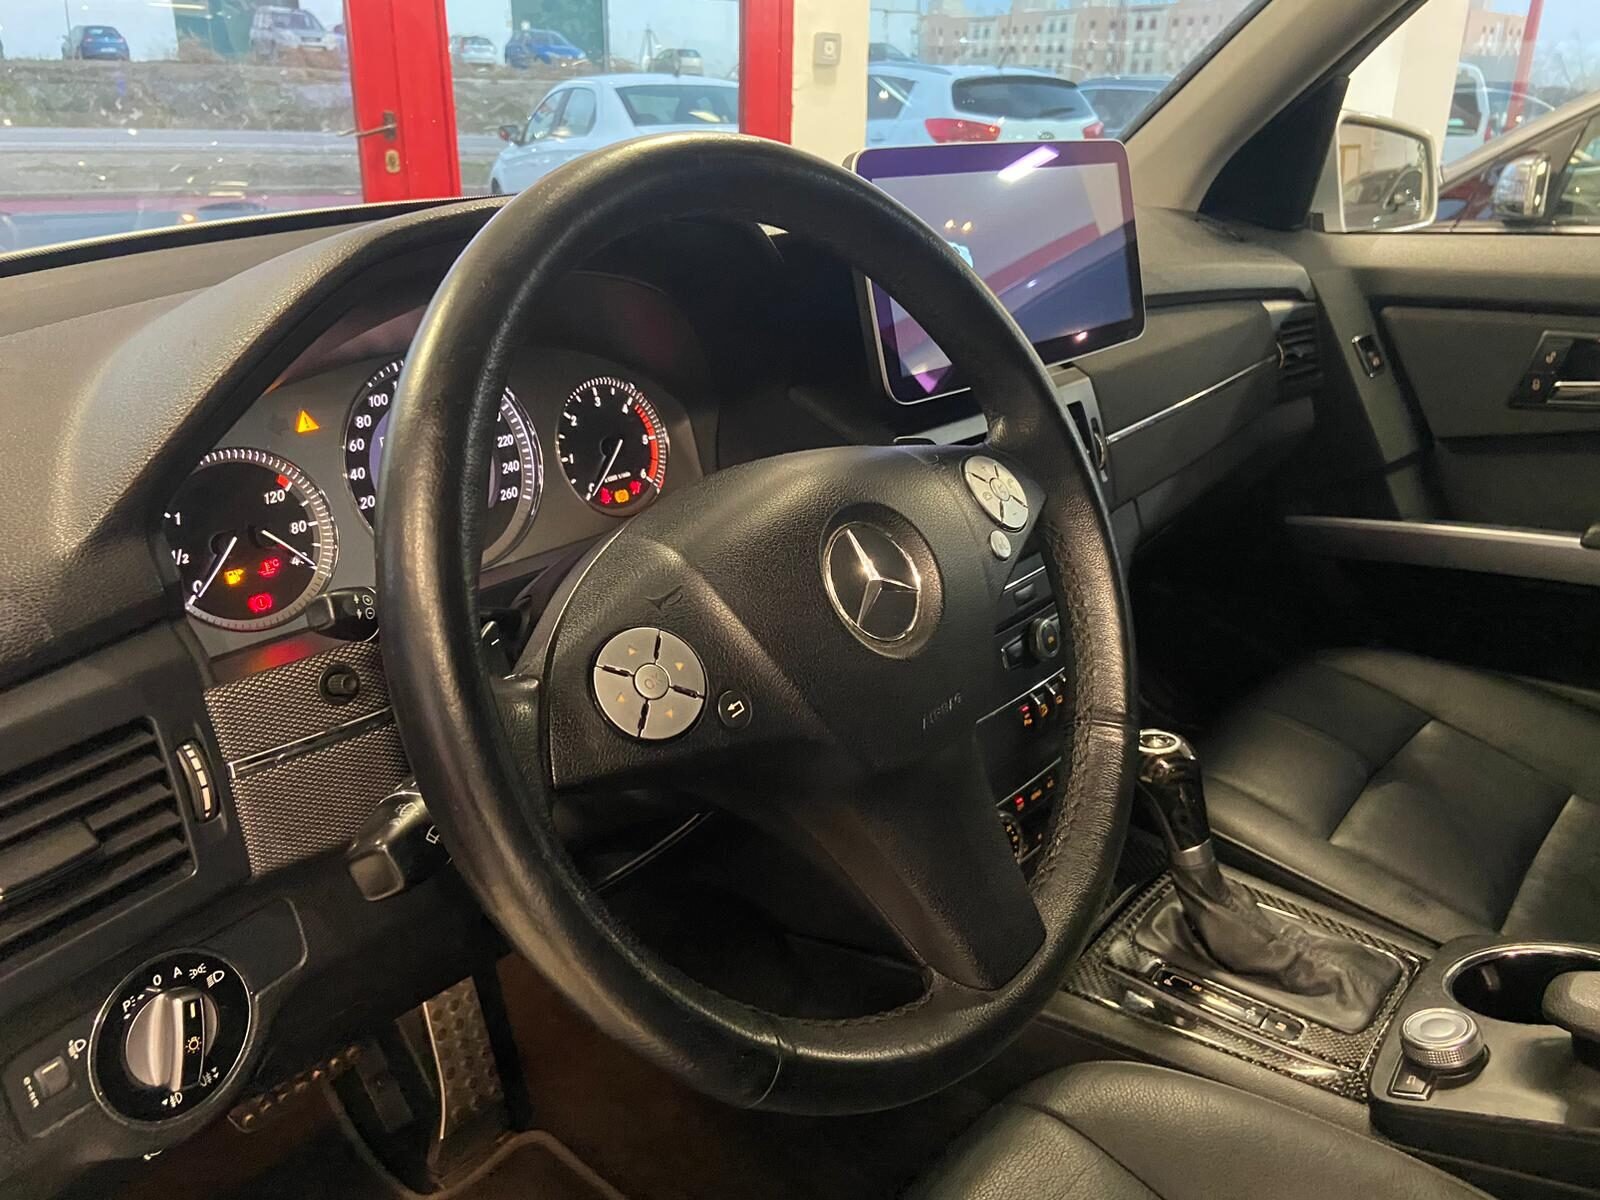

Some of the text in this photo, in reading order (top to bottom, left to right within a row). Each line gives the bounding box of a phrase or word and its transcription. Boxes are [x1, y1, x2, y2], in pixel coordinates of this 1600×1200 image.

[368, 393, 389, 408] 100
[594, 396, 602, 408] 3
[621, 403, 629, 415] 4
[355, 414, 372, 429] 80
[570, 415, 578, 427] 2
[349, 438, 365, 453] 60
[497, 434, 514, 448] 220
[568, 453, 575, 465] 1
[349, 467, 366, 481] 40
[502, 460, 520, 475] 240
[640, 468, 648, 479] 6
[263, 490, 286, 505] 120
[500, 486, 518, 501] 260
[360, 495, 376, 510] 20
[174, 511, 181, 526] 1
[290, 520, 307, 535] 80
[643, 671, 665, 690] OK
[173, 965, 183, 979] A
[122, 999, 132, 1013] P
